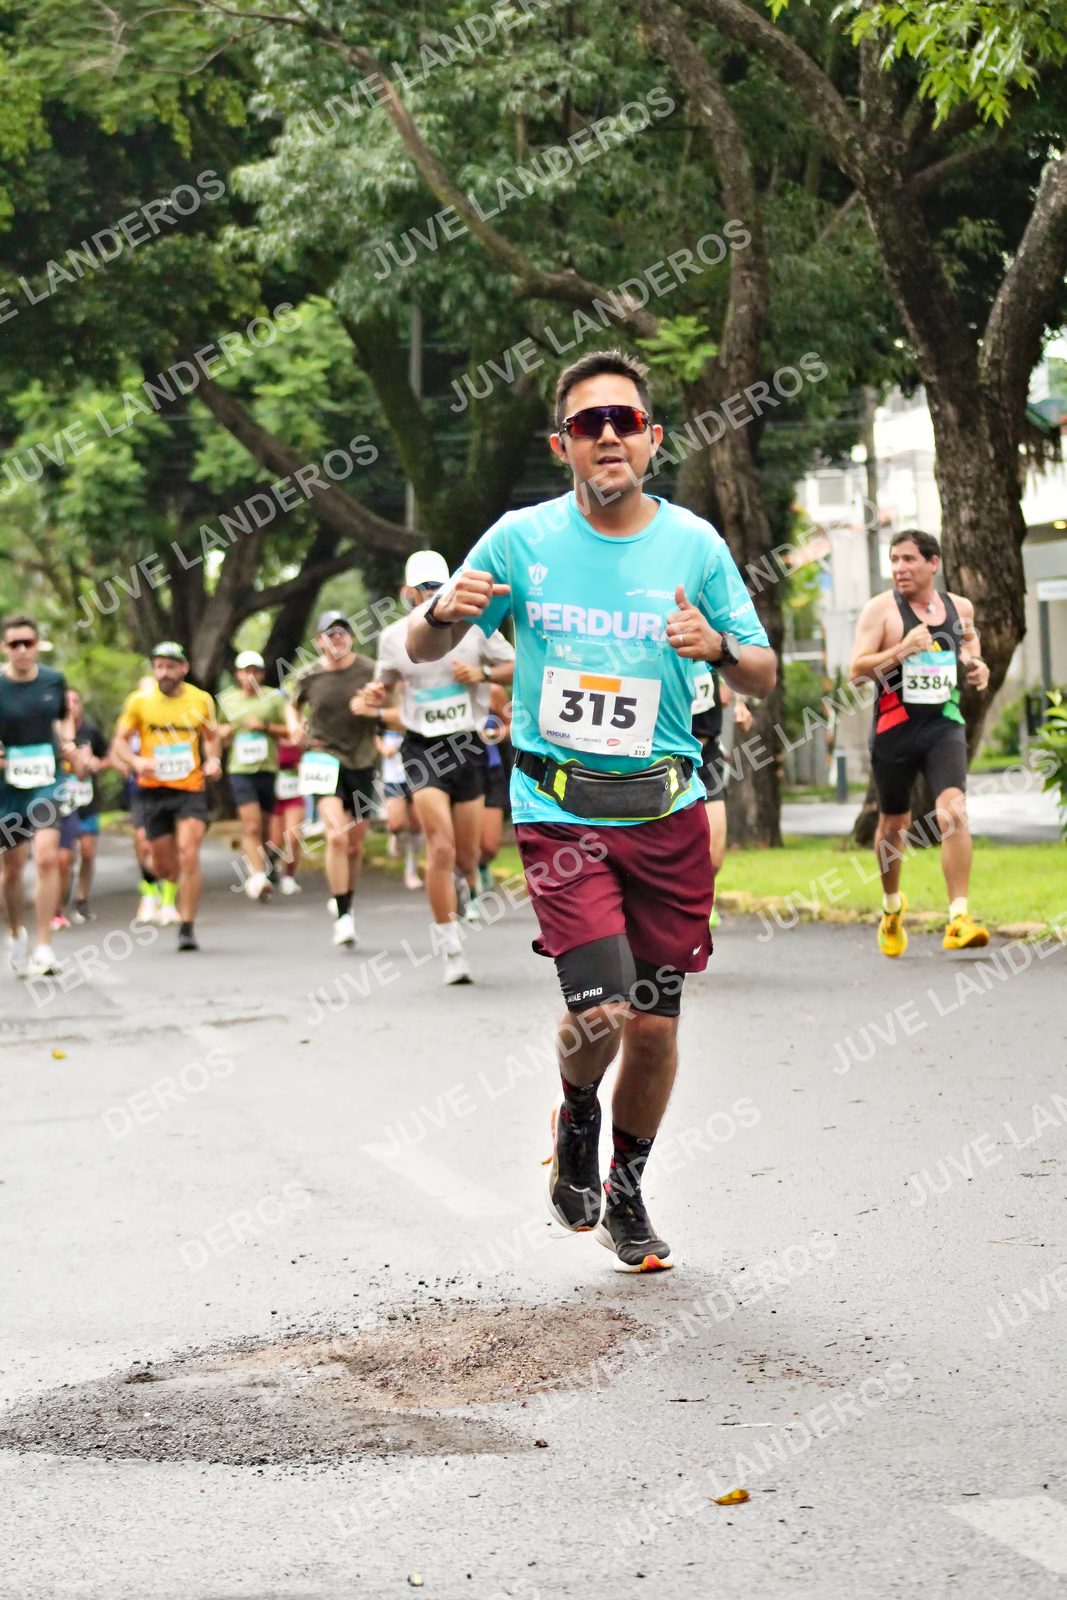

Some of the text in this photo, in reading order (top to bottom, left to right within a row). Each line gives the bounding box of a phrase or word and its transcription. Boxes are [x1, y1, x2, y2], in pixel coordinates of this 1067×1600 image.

[907, 675, 953, 690] 3384
[425, 703, 466, 723] 6407
[559, 689, 637, 729] 315
[546, 730, 571, 739] PERDURA
[582, 987, 603, 999] PRO
